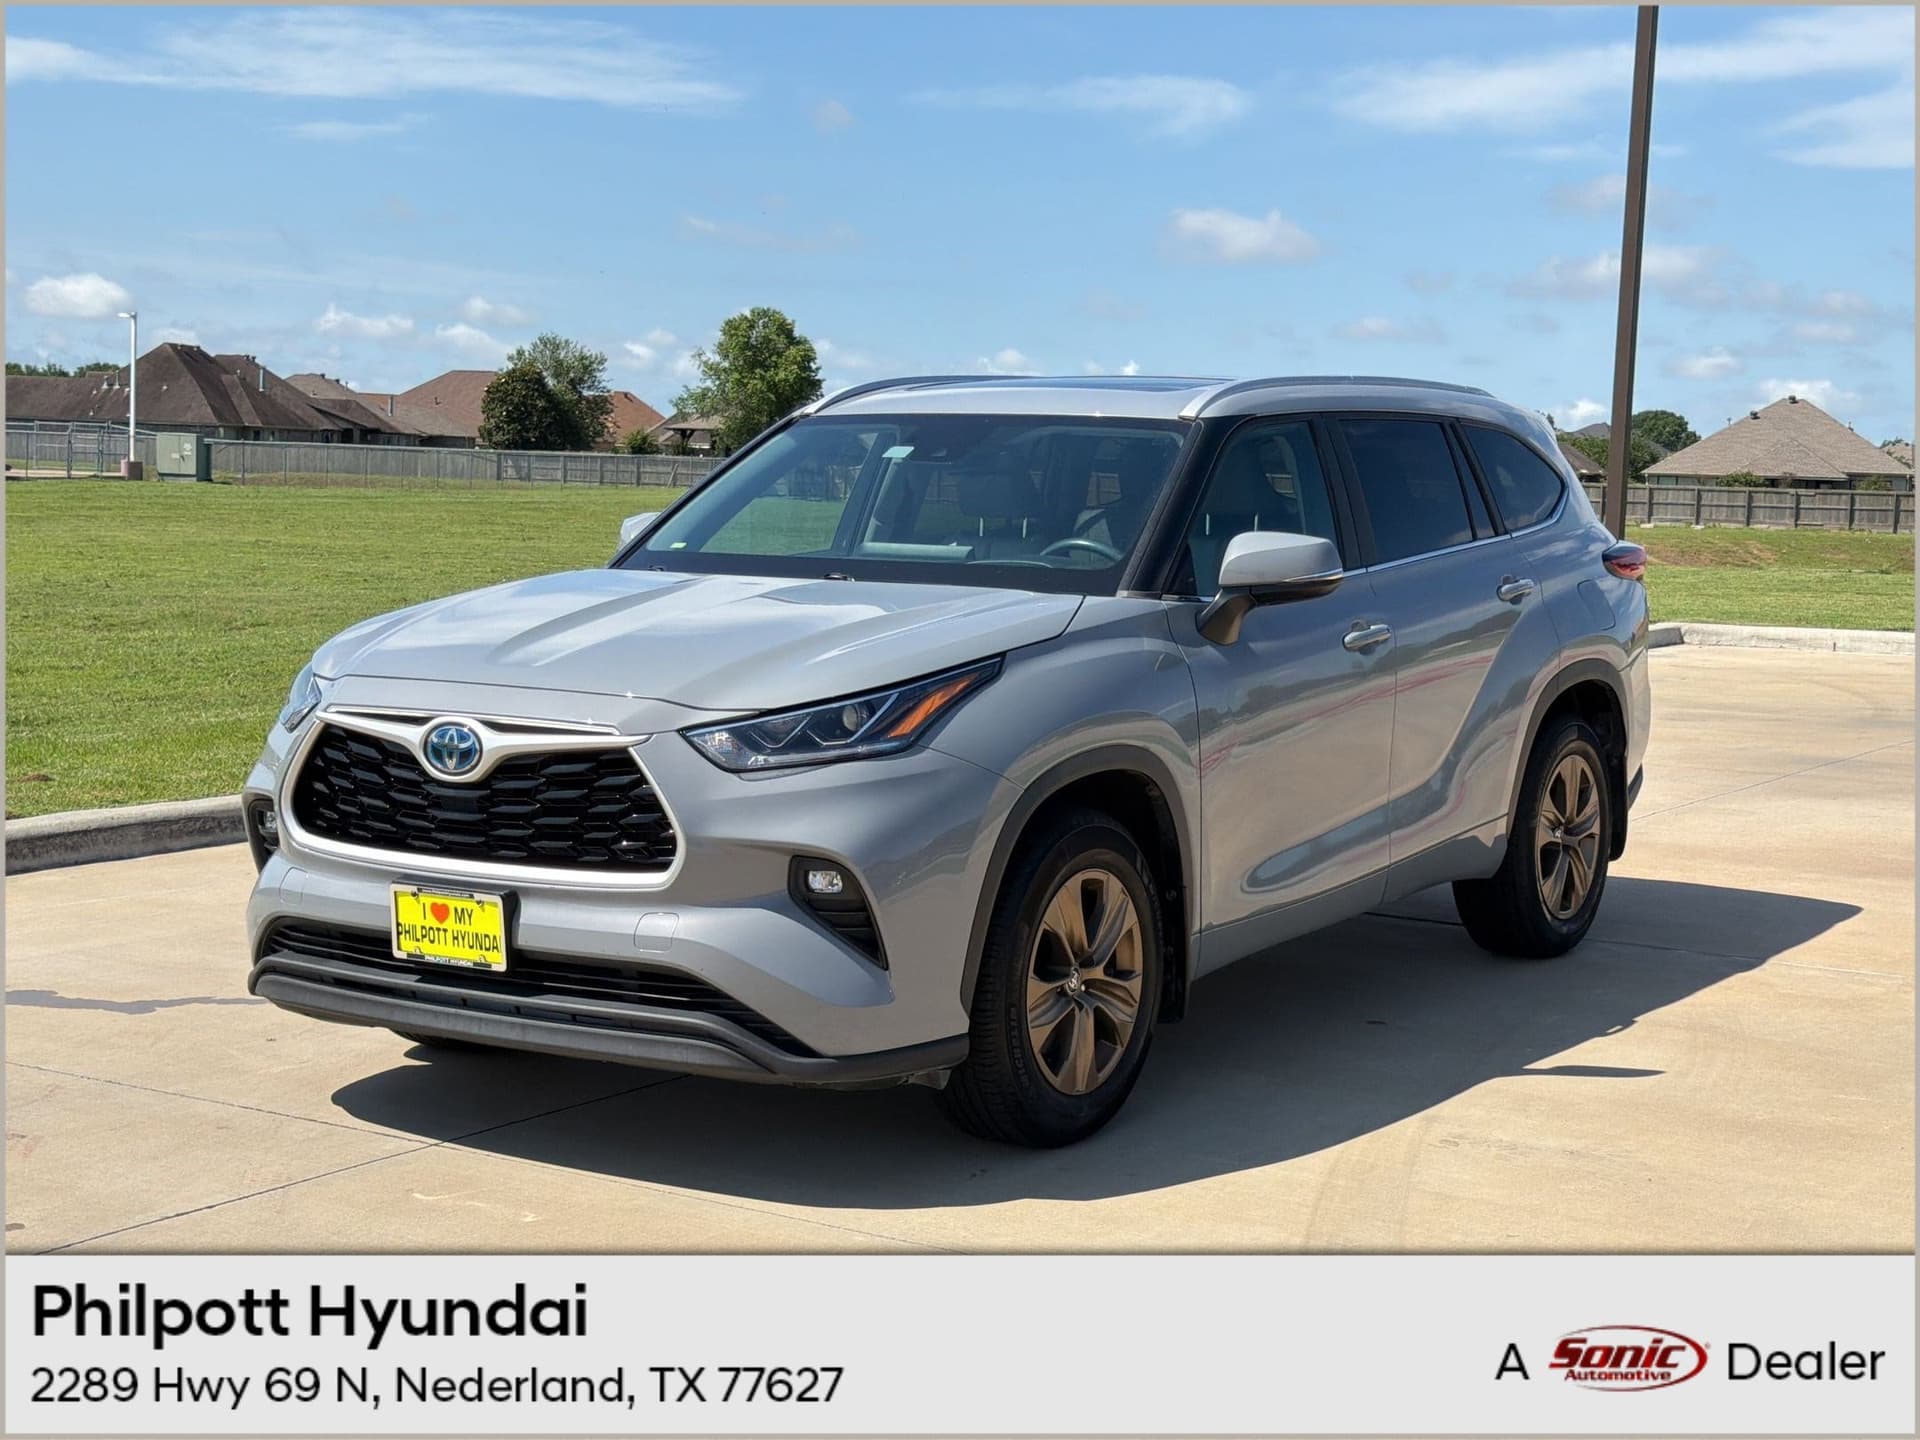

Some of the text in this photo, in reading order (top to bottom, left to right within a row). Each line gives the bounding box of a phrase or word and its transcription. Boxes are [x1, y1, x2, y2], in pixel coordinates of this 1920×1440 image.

[422, 902, 474, 926] I MY
[397, 922, 449, 946] PHILPOTT
